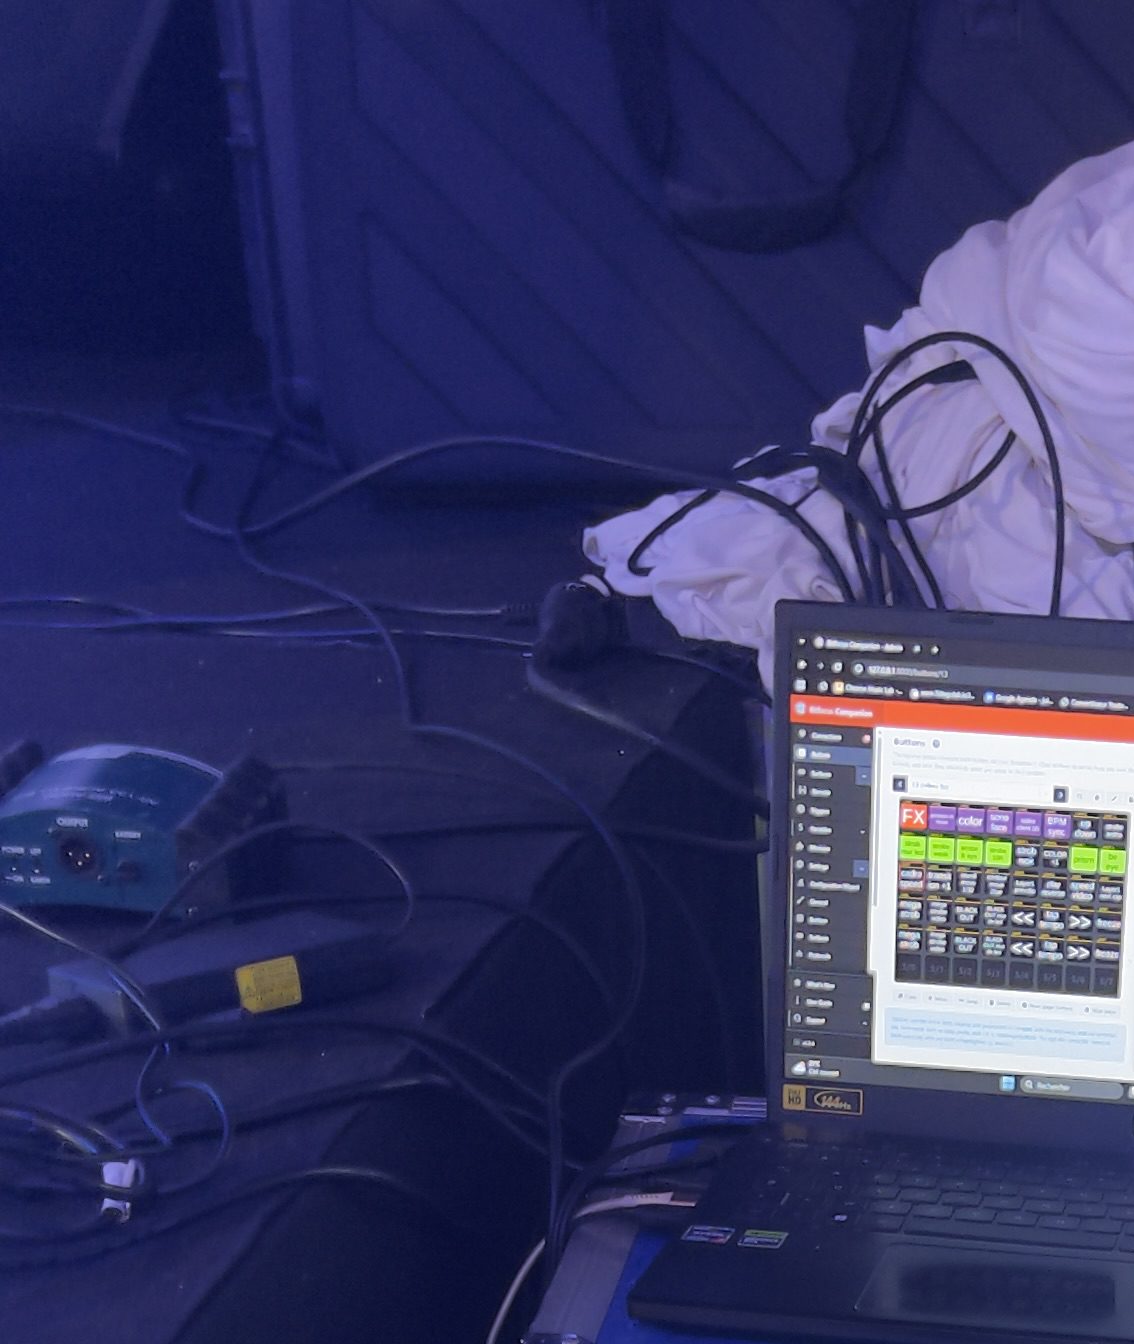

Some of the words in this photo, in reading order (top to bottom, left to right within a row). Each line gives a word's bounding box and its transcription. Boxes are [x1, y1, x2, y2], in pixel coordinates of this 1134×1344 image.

[894, 738, 926, 748] Buttons
[902, 808, 925, 824] FX
[958, 815, 983, 826] color
[1047, 817, 1067, 825] BPM
[788, 1094, 802, 1105] HD
